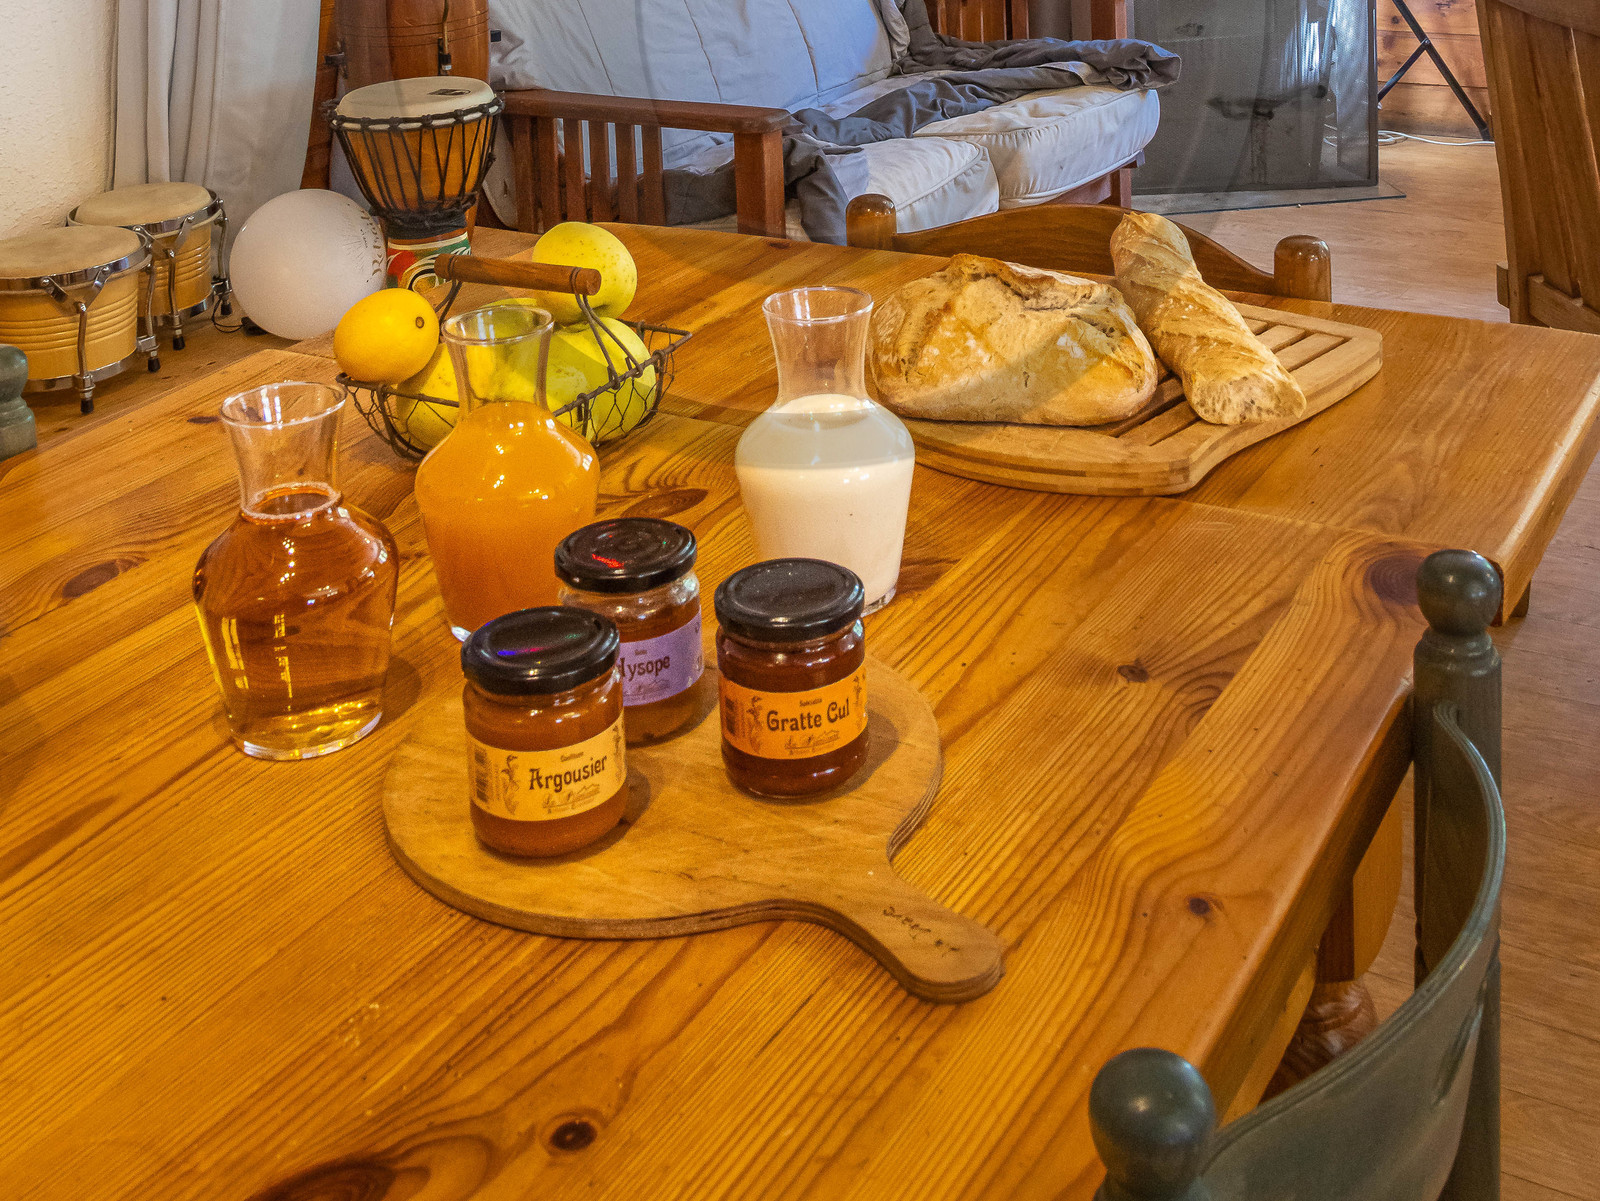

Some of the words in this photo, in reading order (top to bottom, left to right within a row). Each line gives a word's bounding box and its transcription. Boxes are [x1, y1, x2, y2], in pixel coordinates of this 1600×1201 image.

[766, 710, 822, 731] Gratte
[827, 697, 850, 723] Cul
[528, 755, 607, 793] Argousier
